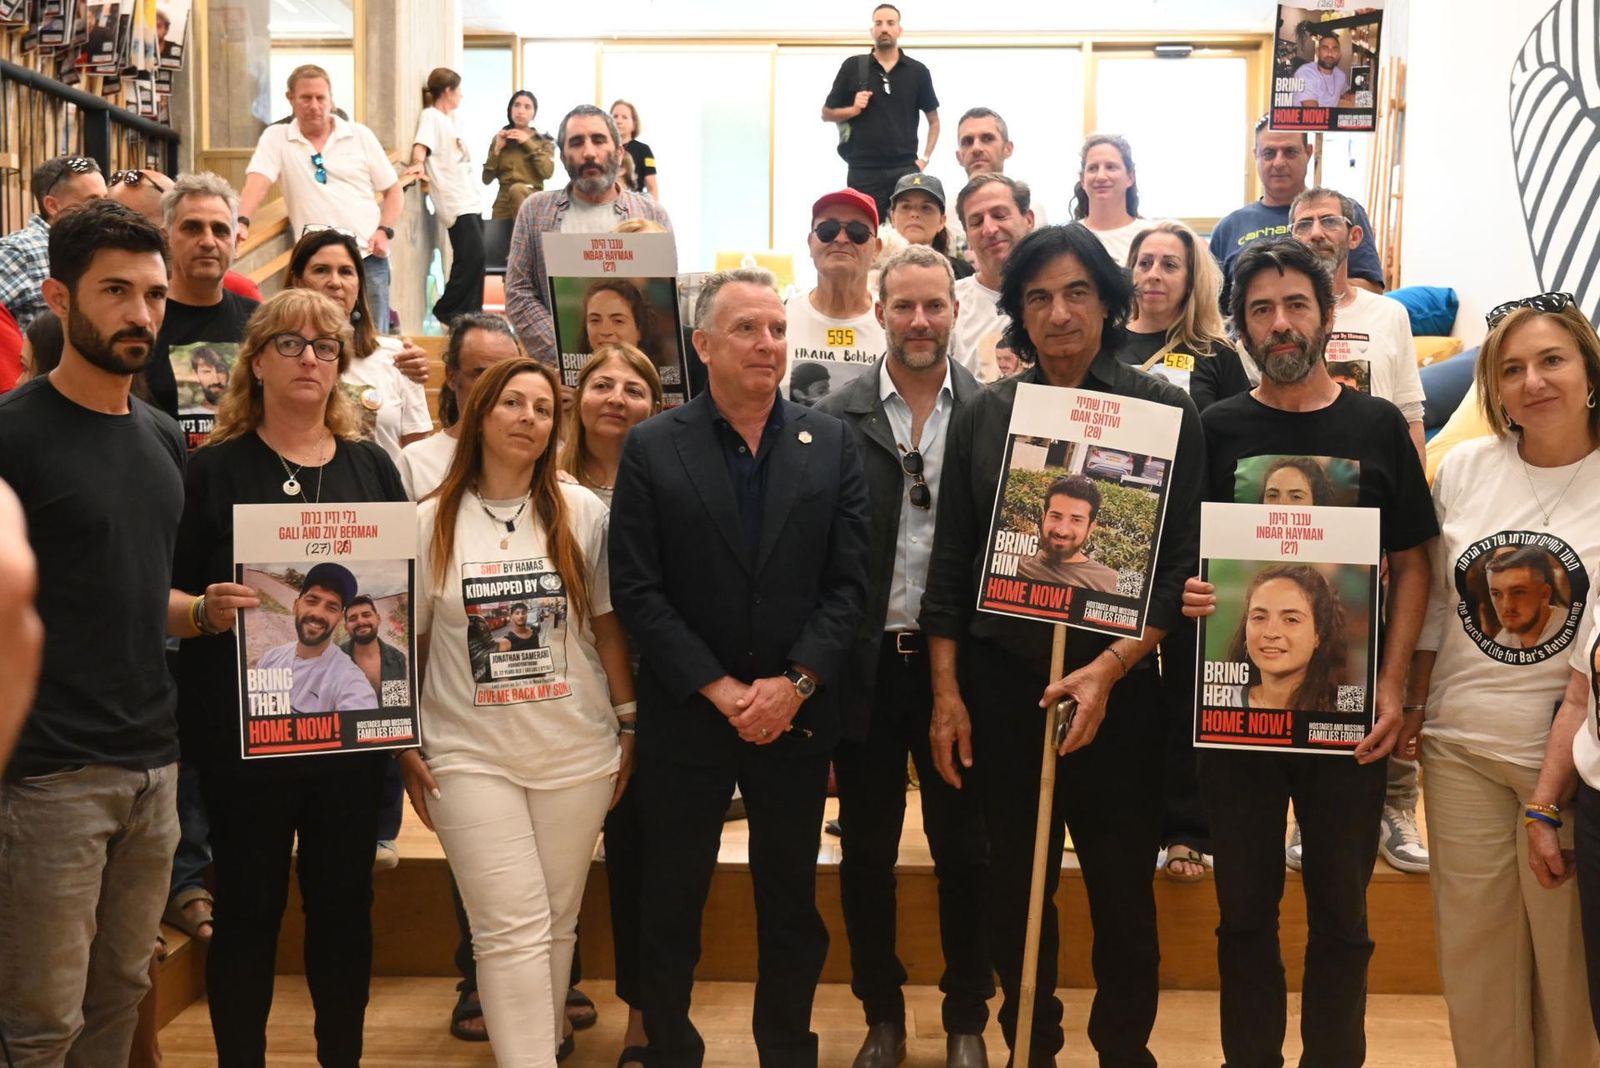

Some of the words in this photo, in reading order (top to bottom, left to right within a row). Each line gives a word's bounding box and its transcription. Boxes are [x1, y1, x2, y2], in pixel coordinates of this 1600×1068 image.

[1276, 78, 1304, 92] BRING
[1274, 92, 1293, 107] HIM
[1274, 108, 1300, 123] HOME
[1302, 108, 1330, 123] NOW!
[584, 250, 604, 260] INBAR
[605, 250, 634, 260] HAYMAN
[602, 262, 616, 272] (27)
[828, 329, 854, 345] 595
[1076, 396, 1100, 411] שתיוי
[1102, 400, 1120, 414] עידן
[1070, 409, 1091, 423] IDAN
[1092, 412, 1120, 428] SHTIVI
[1084, 424, 1102, 440] (28)
[301, 511, 321, 526] ברמן
[1269, 512, 1288, 526] הימן
[1290, 512, 1312, 526] ענבר
[279, 526, 300, 540] GALI
[302, 526, 320, 540] AND
[324, 526, 338, 539] ZIV
[340, 525, 378, 538] BERMAN
[1256, 526, 1283, 539] INBAR
[1286, 526, 1324, 540] HAYMAN
[1492, 534, 1506, 546] של
[306, 542, 331, 556] (27)
[994, 530, 1039, 557] BRING
[1280, 541, 1298, 556] (27)
[1479, 540, 1491, 551] בר
[990, 554, 1020, 577] HIM
[1458, 546, 1480, 572] הביתה
[480, 564, 501, 575] SHOT
[504, 562, 514, 574] BY
[515, 560, 544, 572] HAMAS
[466, 580, 522, 599] KIDNAPPED
[524, 578, 538, 594] BY
[986, 577, 1028, 604] HOME
[1030, 584, 1073, 611] NOW!
[1084, 608, 1113, 622] FAMILIES
[1114, 612, 1138, 627] FORUM
[1459, 600, 1468, 616] The
[1464, 616, 1482, 642] March
[1481, 638, 1492, 648] of
[1488, 642, 1504, 659] Life
[1505, 649, 1517, 662] for
[1520, 649, 1545, 663] Bar's
[1544, 628, 1574, 655] Return
[1566, 601, 1582, 627] Home
[492, 652, 520, 664] JONATHAN
[247, 667, 294, 692] BRING
[1204, 660, 1250, 684] BRING
[478, 689, 496, 704] GIVE
[497, 688, 510, 702] ME
[512, 686, 536, 700] BACK
[538, 684, 552, 698] MY
[1203, 684, 1232, 707] HER
[248, 691, 291, 716] THEM
[249, 719, 292, 744] HOME
[296, 713, 342, 741] NOW!
[1202, 710, 1244, 733] HOME
[1248, 711, 1292, 736] NOW!
[1308, 722, 1333, 730] HOSTAGES
[1334, 723, 1343, 731] AND
[357, 726, 388, 740] FAMILIES
[388, 725, 413, 738] FORUM
[1308, 730, 1340, 742] FAMILIES
[1340, 732, 1364, 743] FORUM
